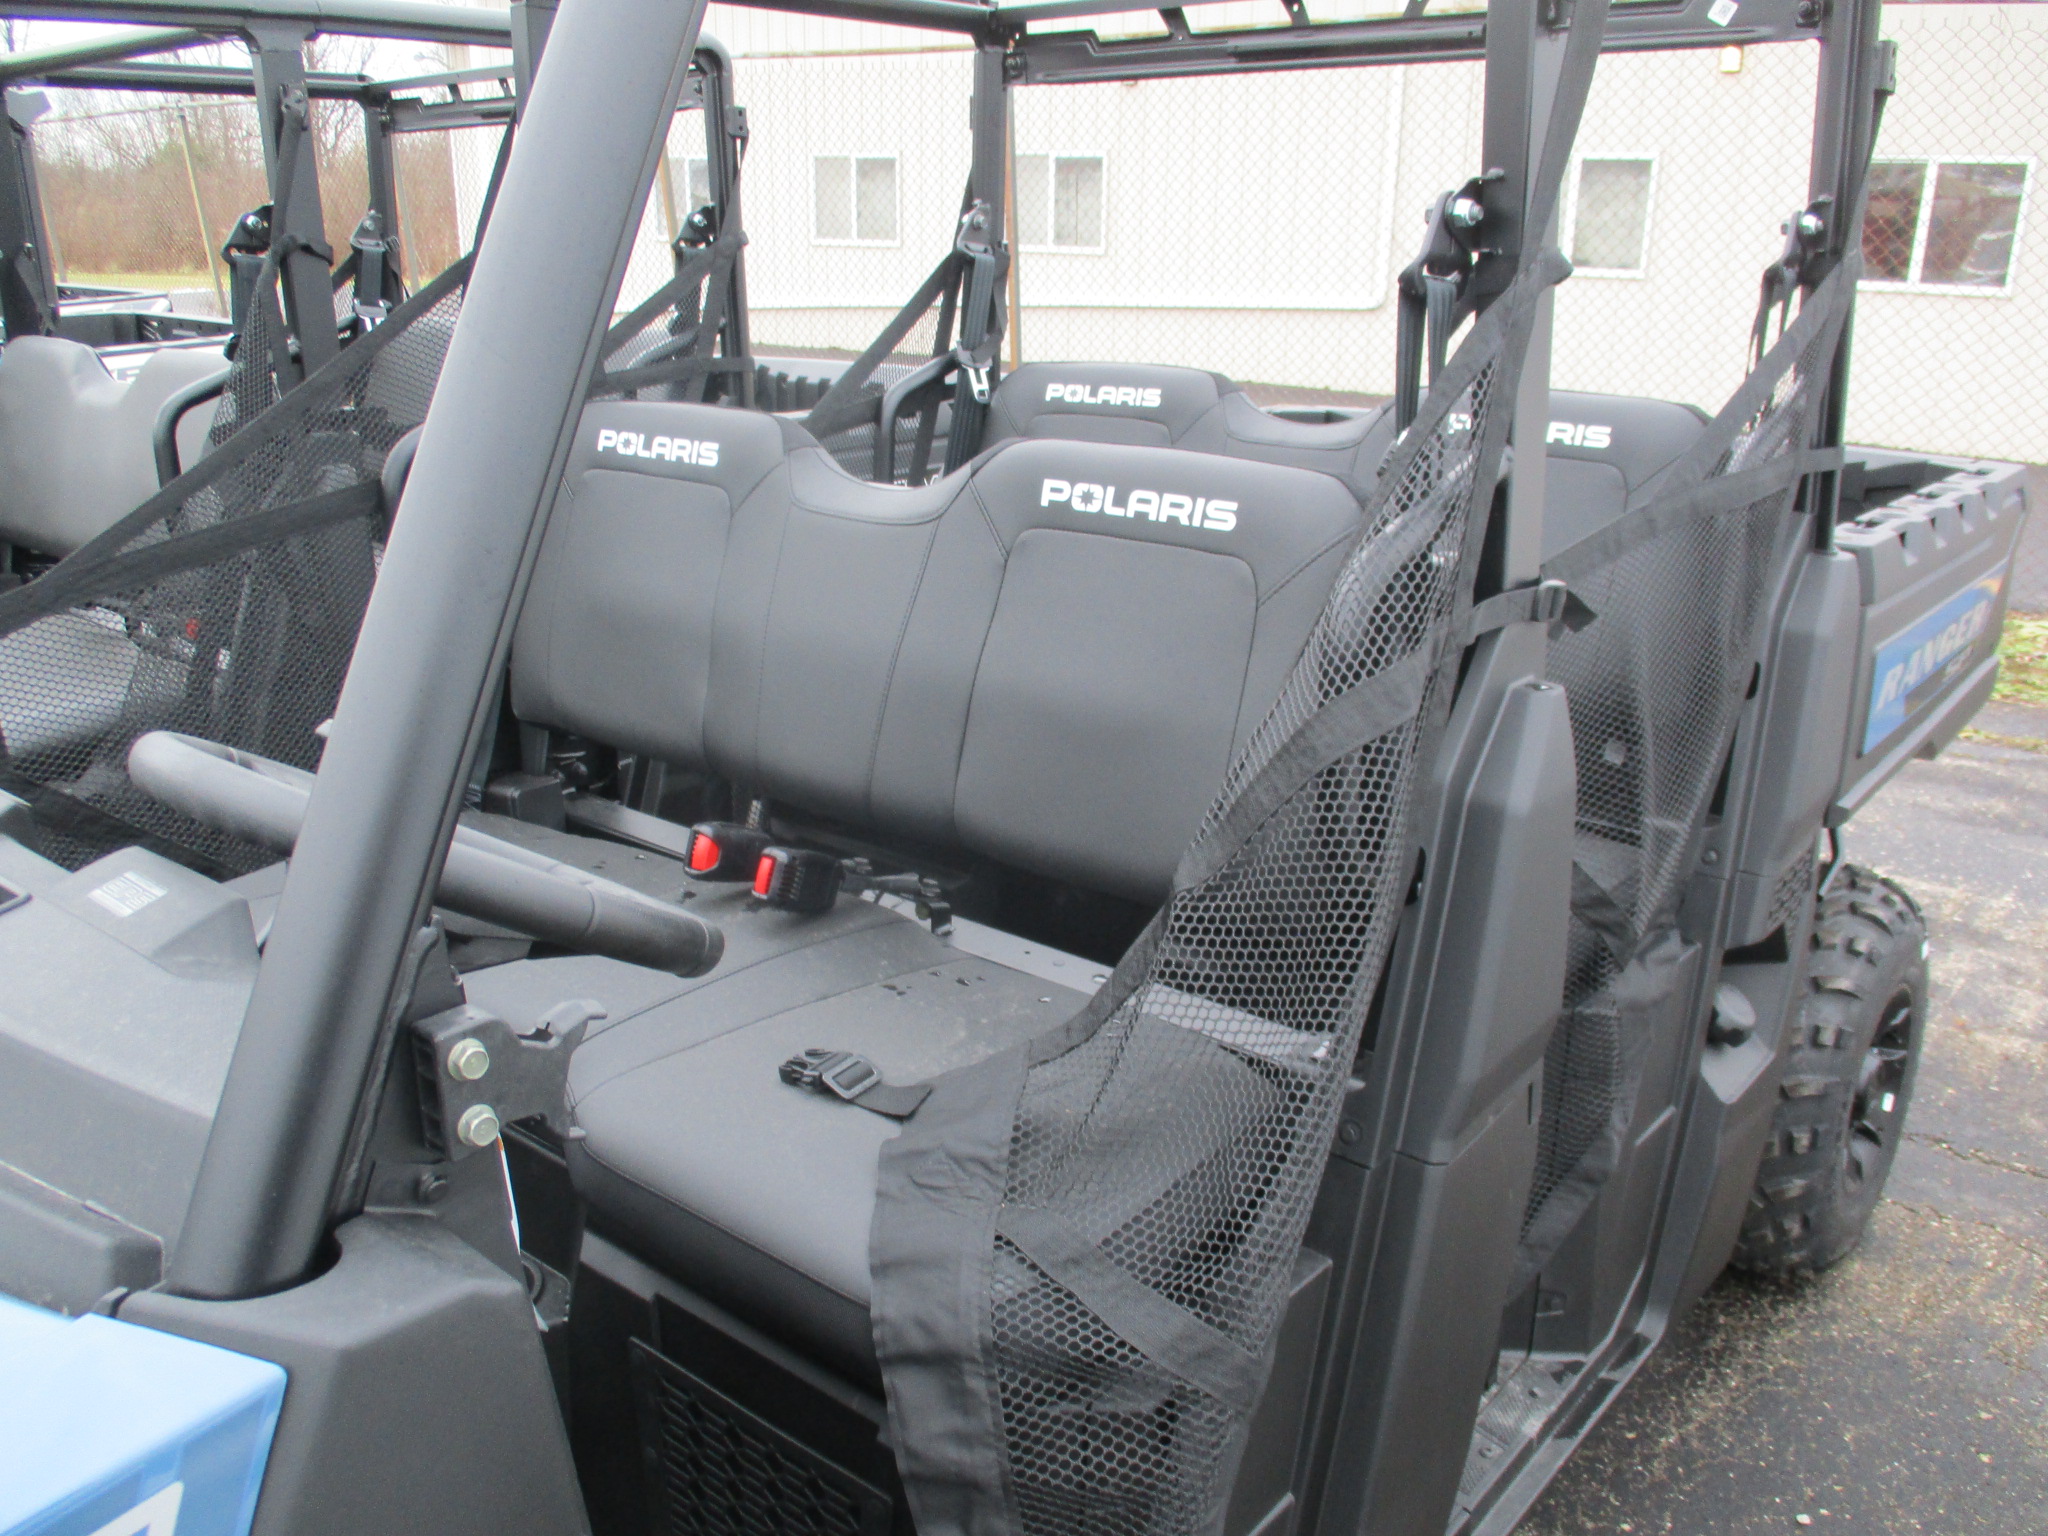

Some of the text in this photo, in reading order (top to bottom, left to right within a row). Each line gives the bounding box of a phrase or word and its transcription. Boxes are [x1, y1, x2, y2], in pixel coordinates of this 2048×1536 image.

[1045, 383, 1162, 408] POLARIS
[597, 429, 720, 468] POLARIS
[1040, 478, 1239, 532] POLARIS
[1875, 599, 1989, 712] RANGER
